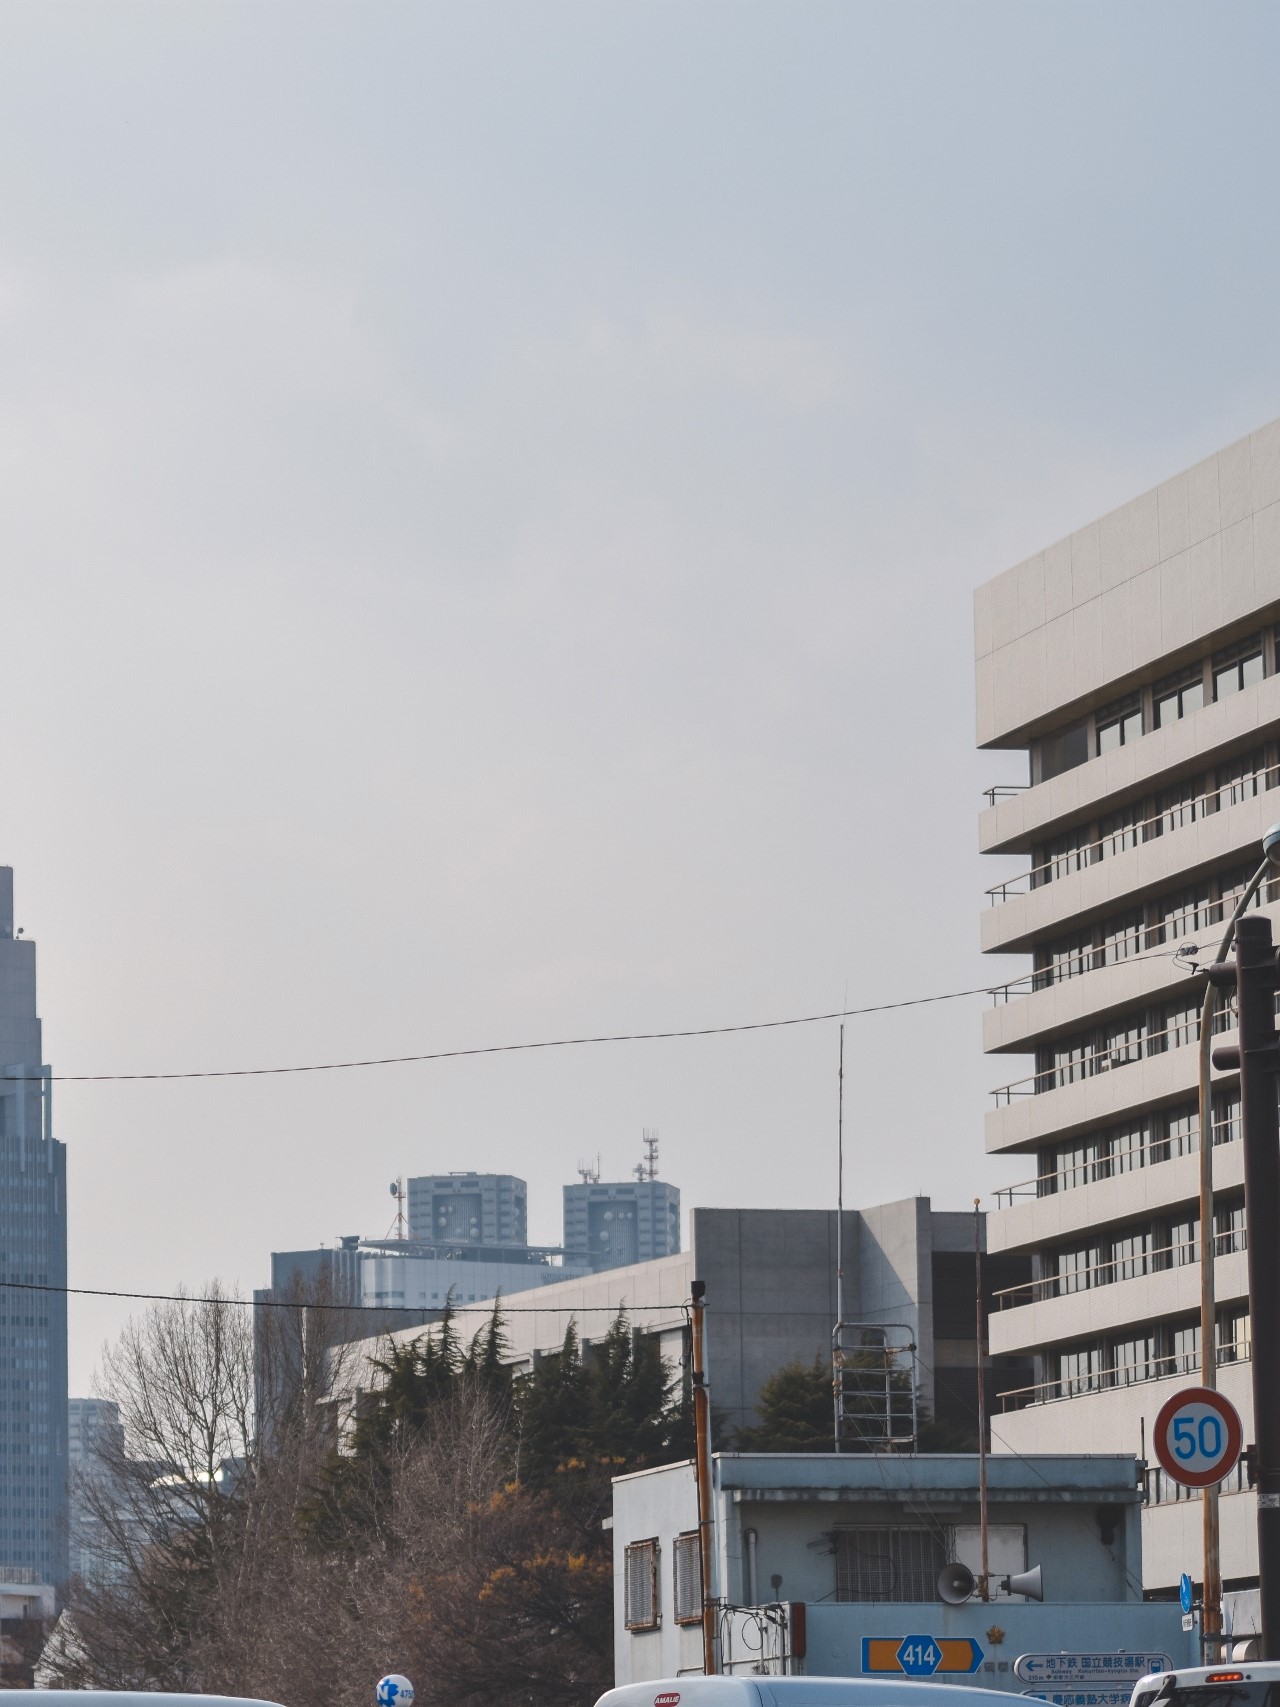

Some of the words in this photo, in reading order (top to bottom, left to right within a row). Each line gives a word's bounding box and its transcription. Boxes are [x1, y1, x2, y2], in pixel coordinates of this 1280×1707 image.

[1173, 1415, 1222, 1460] 50
[903, 1644, 936, 1666] 414
[1046, 1657, 1077, 1669] 地下鉄
[1081, 1656, 1146, 1669] 国立競技場駅
[655, 1695, 680, 1704] AMALIE
